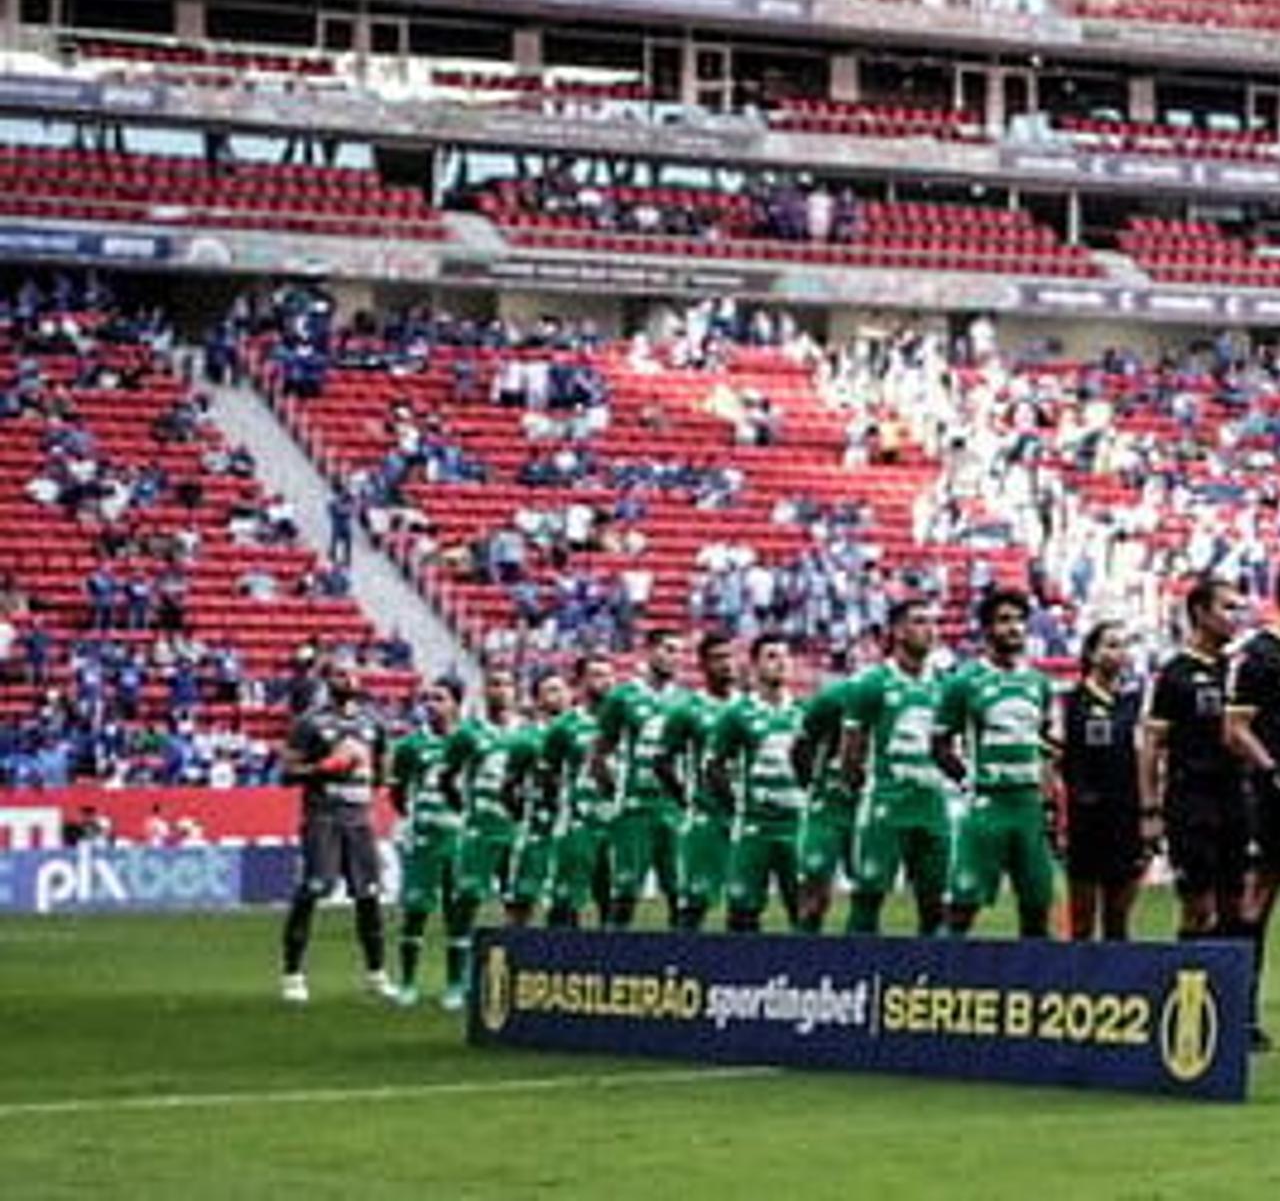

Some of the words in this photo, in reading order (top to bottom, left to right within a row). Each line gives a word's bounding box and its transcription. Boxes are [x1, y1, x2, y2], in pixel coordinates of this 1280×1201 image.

[37, 840, 231, 913] pixbet
[516, 965, 700, 1020] BRASILEIRÃO
[705, 974, 866, 1035] sportingbet
[883, 974, 1000, 1035] SÉRIE
[1004, 991, 1033, 1036] B
[1038, 992, 1150, 1045] 2022
